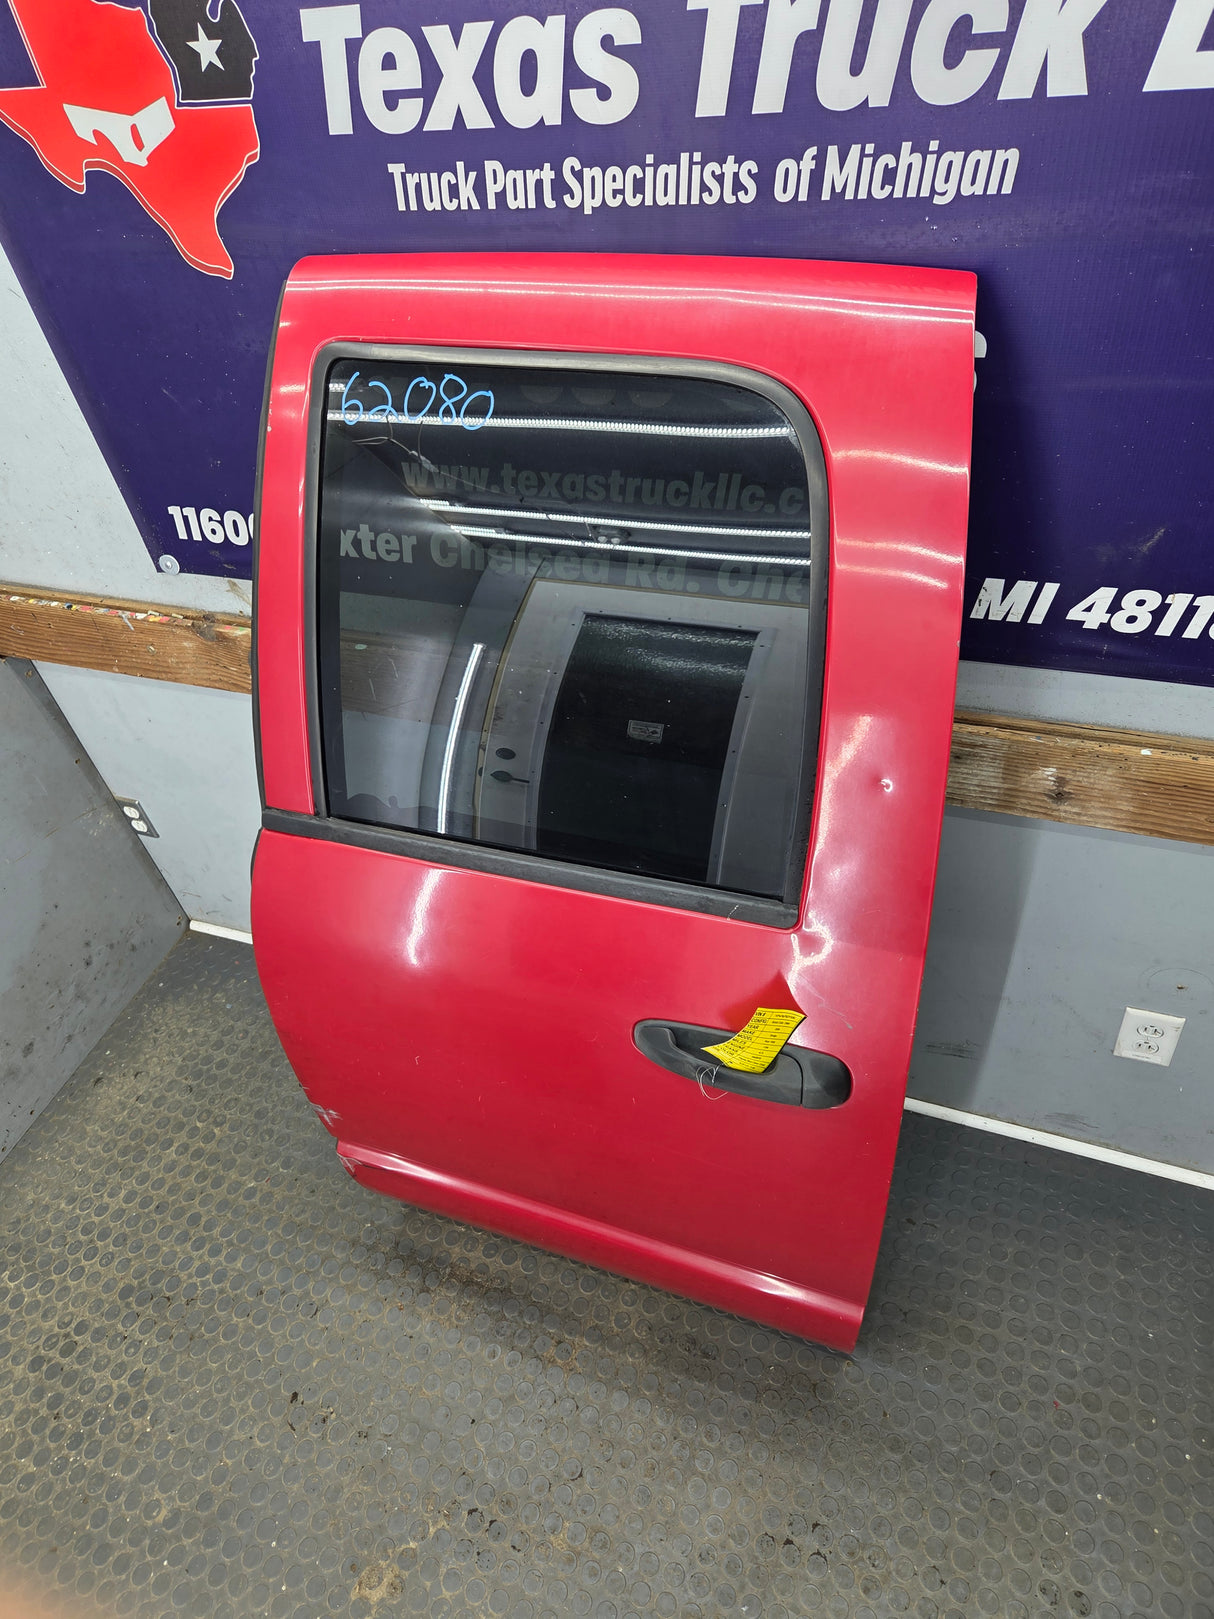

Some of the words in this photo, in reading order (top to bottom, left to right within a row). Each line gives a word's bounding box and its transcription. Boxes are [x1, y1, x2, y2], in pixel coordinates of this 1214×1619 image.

[300, 3, 642, 135] Texas
[686, 0, 1107, 118] Truck
[387, 160, 480, 212] Truck
[484, 158, 556, 210] Part
[563, 151, 758, 214] Specialists
[774, 145, 817, 203] of
[821, 140, 1020, 205] Michigan
[341, 371, 495, 431] 62080
[624, 552, 700, 593] Rd.
[970, 577, 1061, 625] MI
[1065, 587, 1214, 640] 4811
